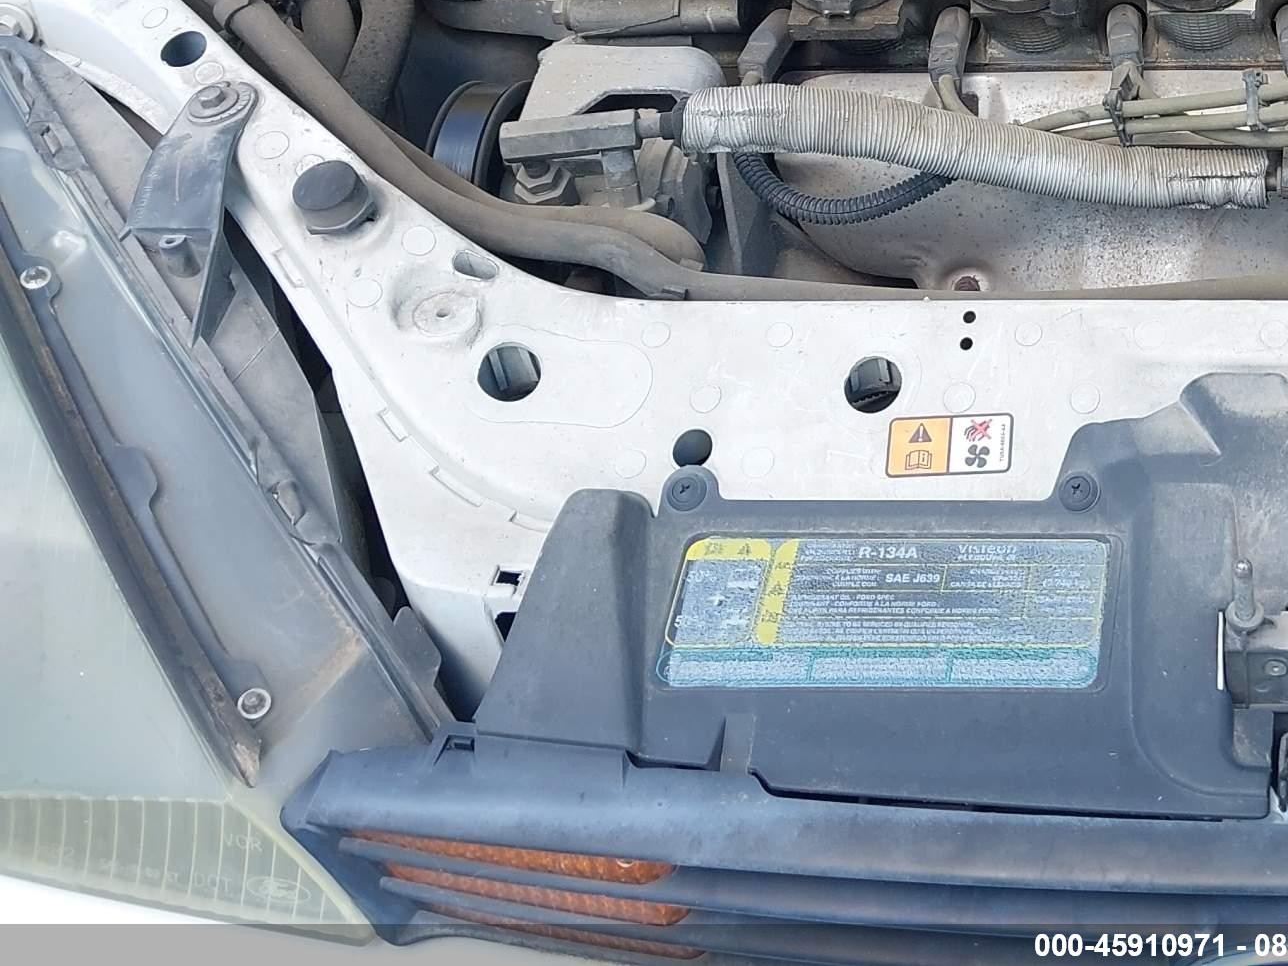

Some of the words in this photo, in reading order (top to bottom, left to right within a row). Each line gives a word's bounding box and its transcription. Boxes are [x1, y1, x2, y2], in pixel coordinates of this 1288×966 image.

[858, 545, 918, 559] R-134A
[885, 574, 910, 583] SAE
[913, 574, 940, 583] J639
